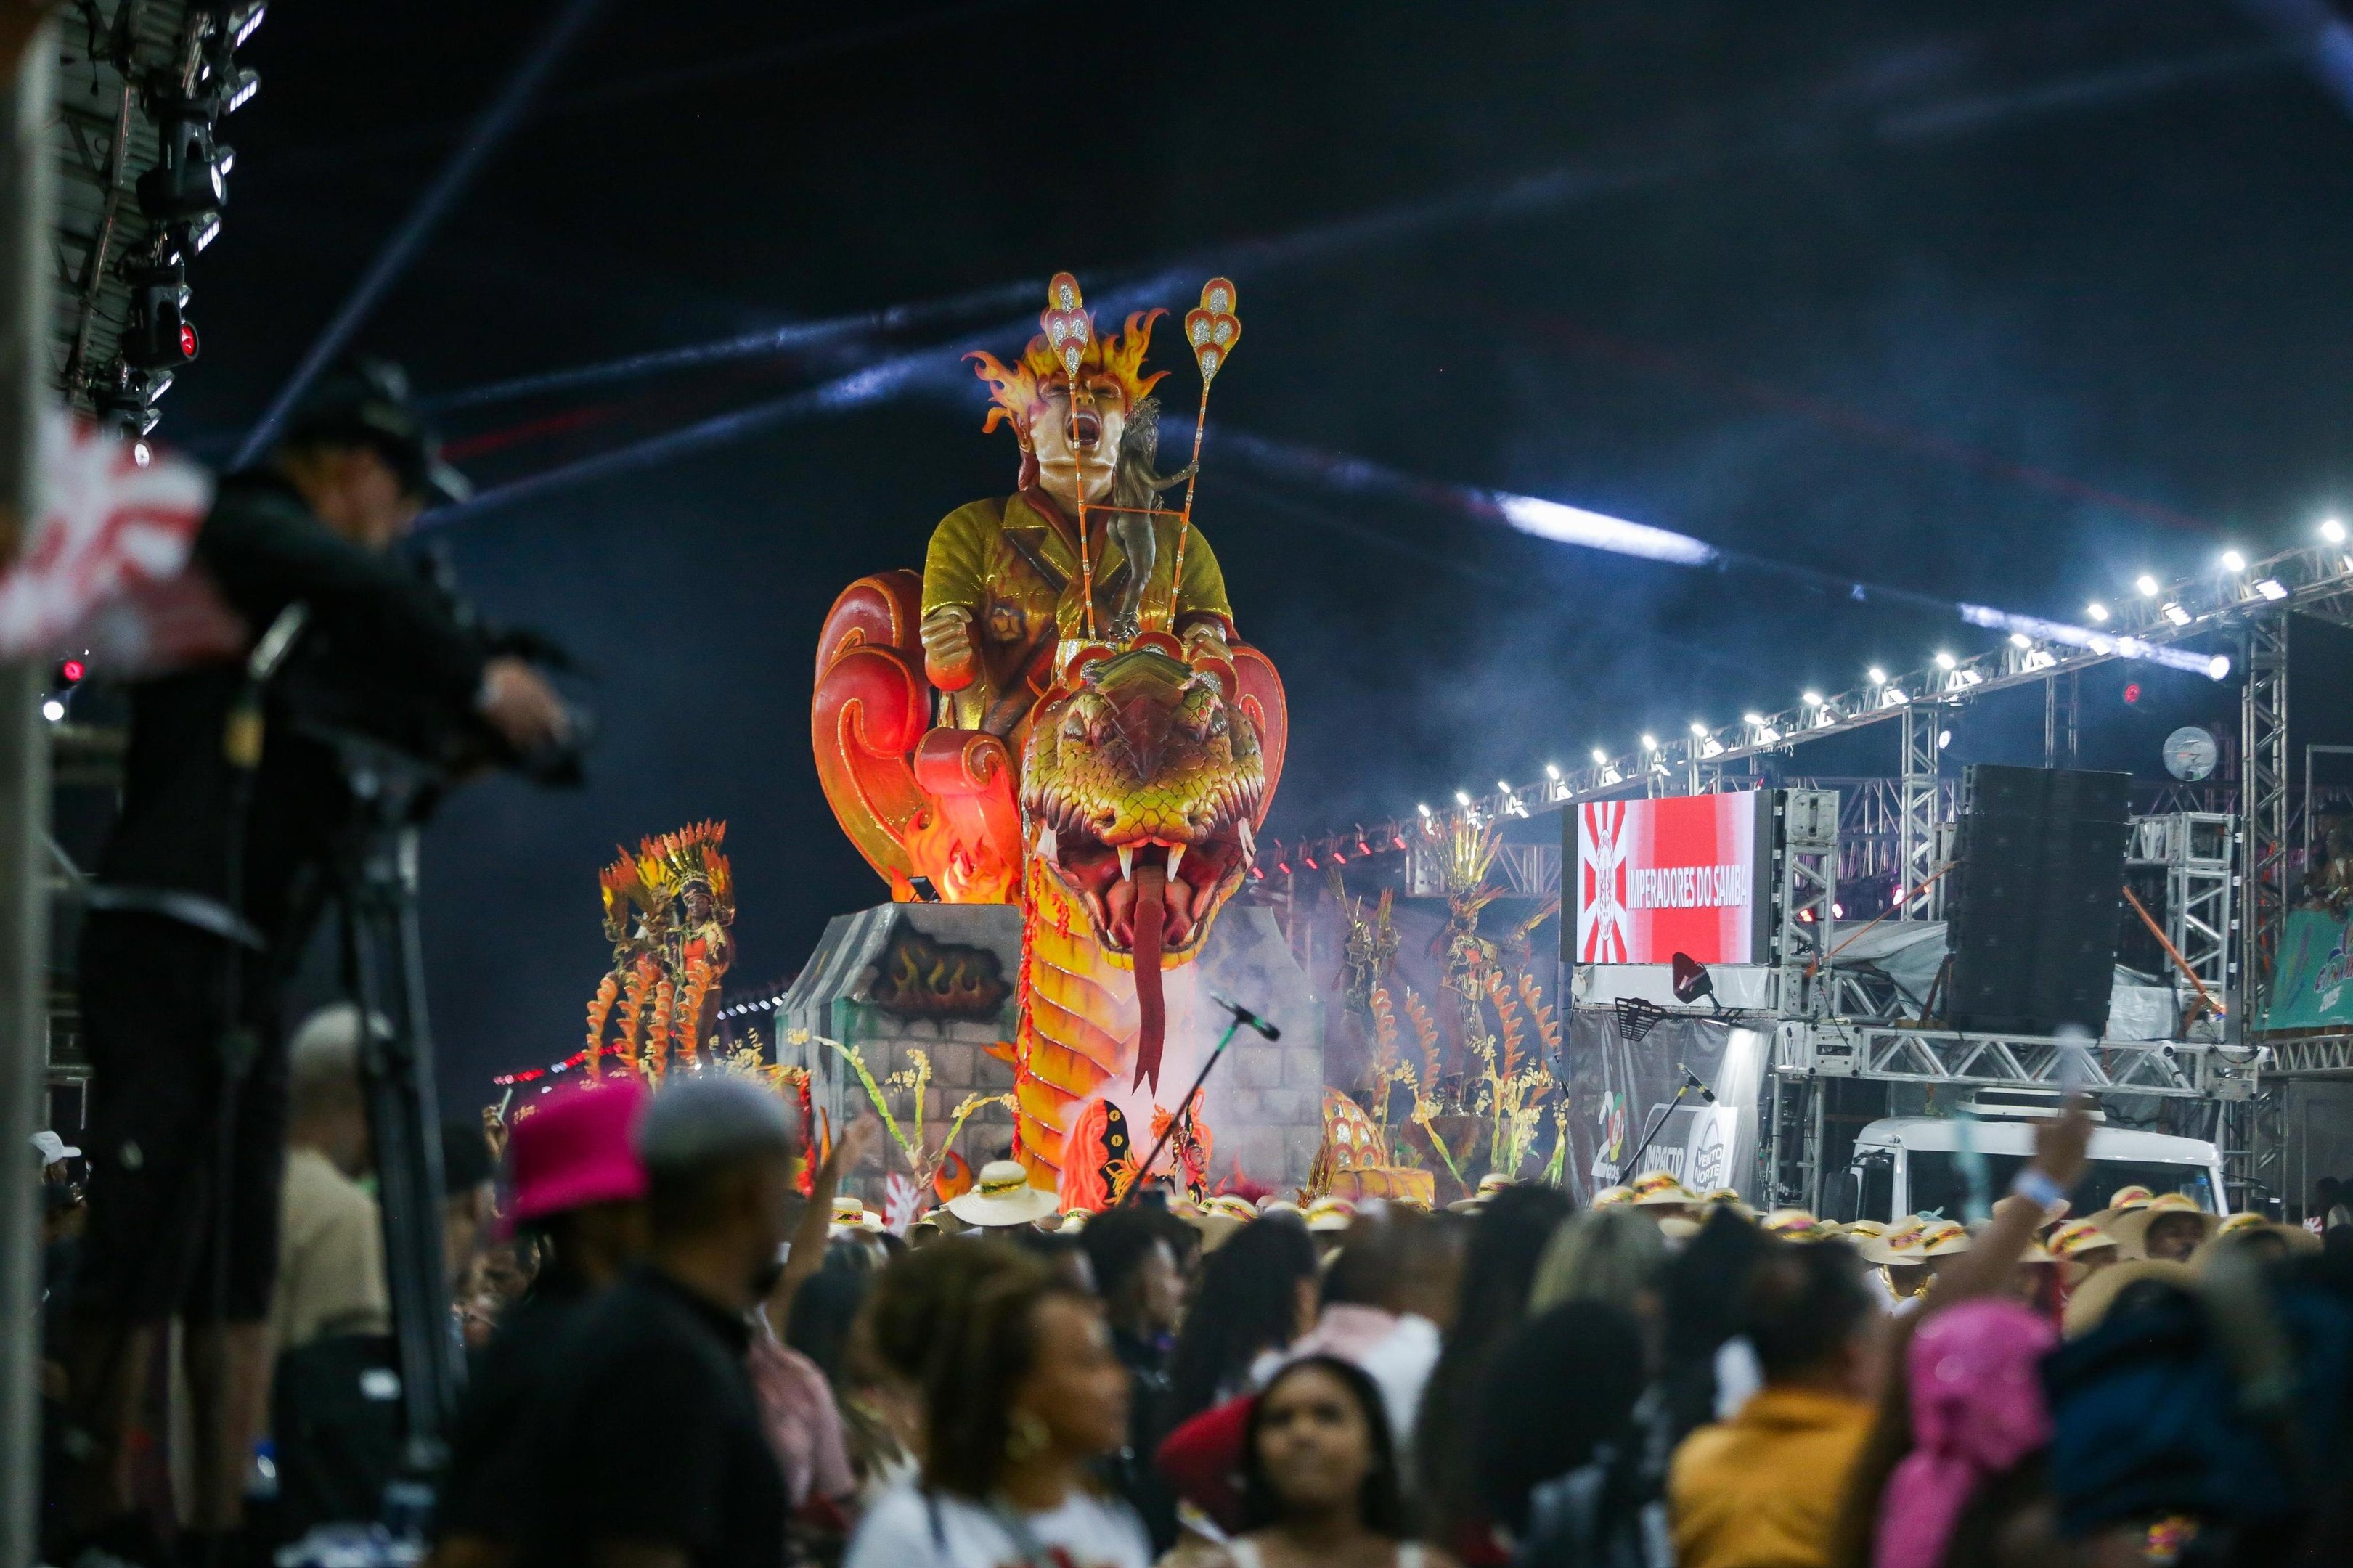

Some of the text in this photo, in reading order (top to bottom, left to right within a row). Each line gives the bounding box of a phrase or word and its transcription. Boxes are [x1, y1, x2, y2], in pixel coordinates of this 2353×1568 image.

[1628, 865, 1748, 909] IMPERADORES DO SAMBA
[1644, 1144, 1684, 1179] IMPACTO
[1697, 1147, 1722, 1167] VENTO
[1695, 1163, 1720, 1183] NORTE
